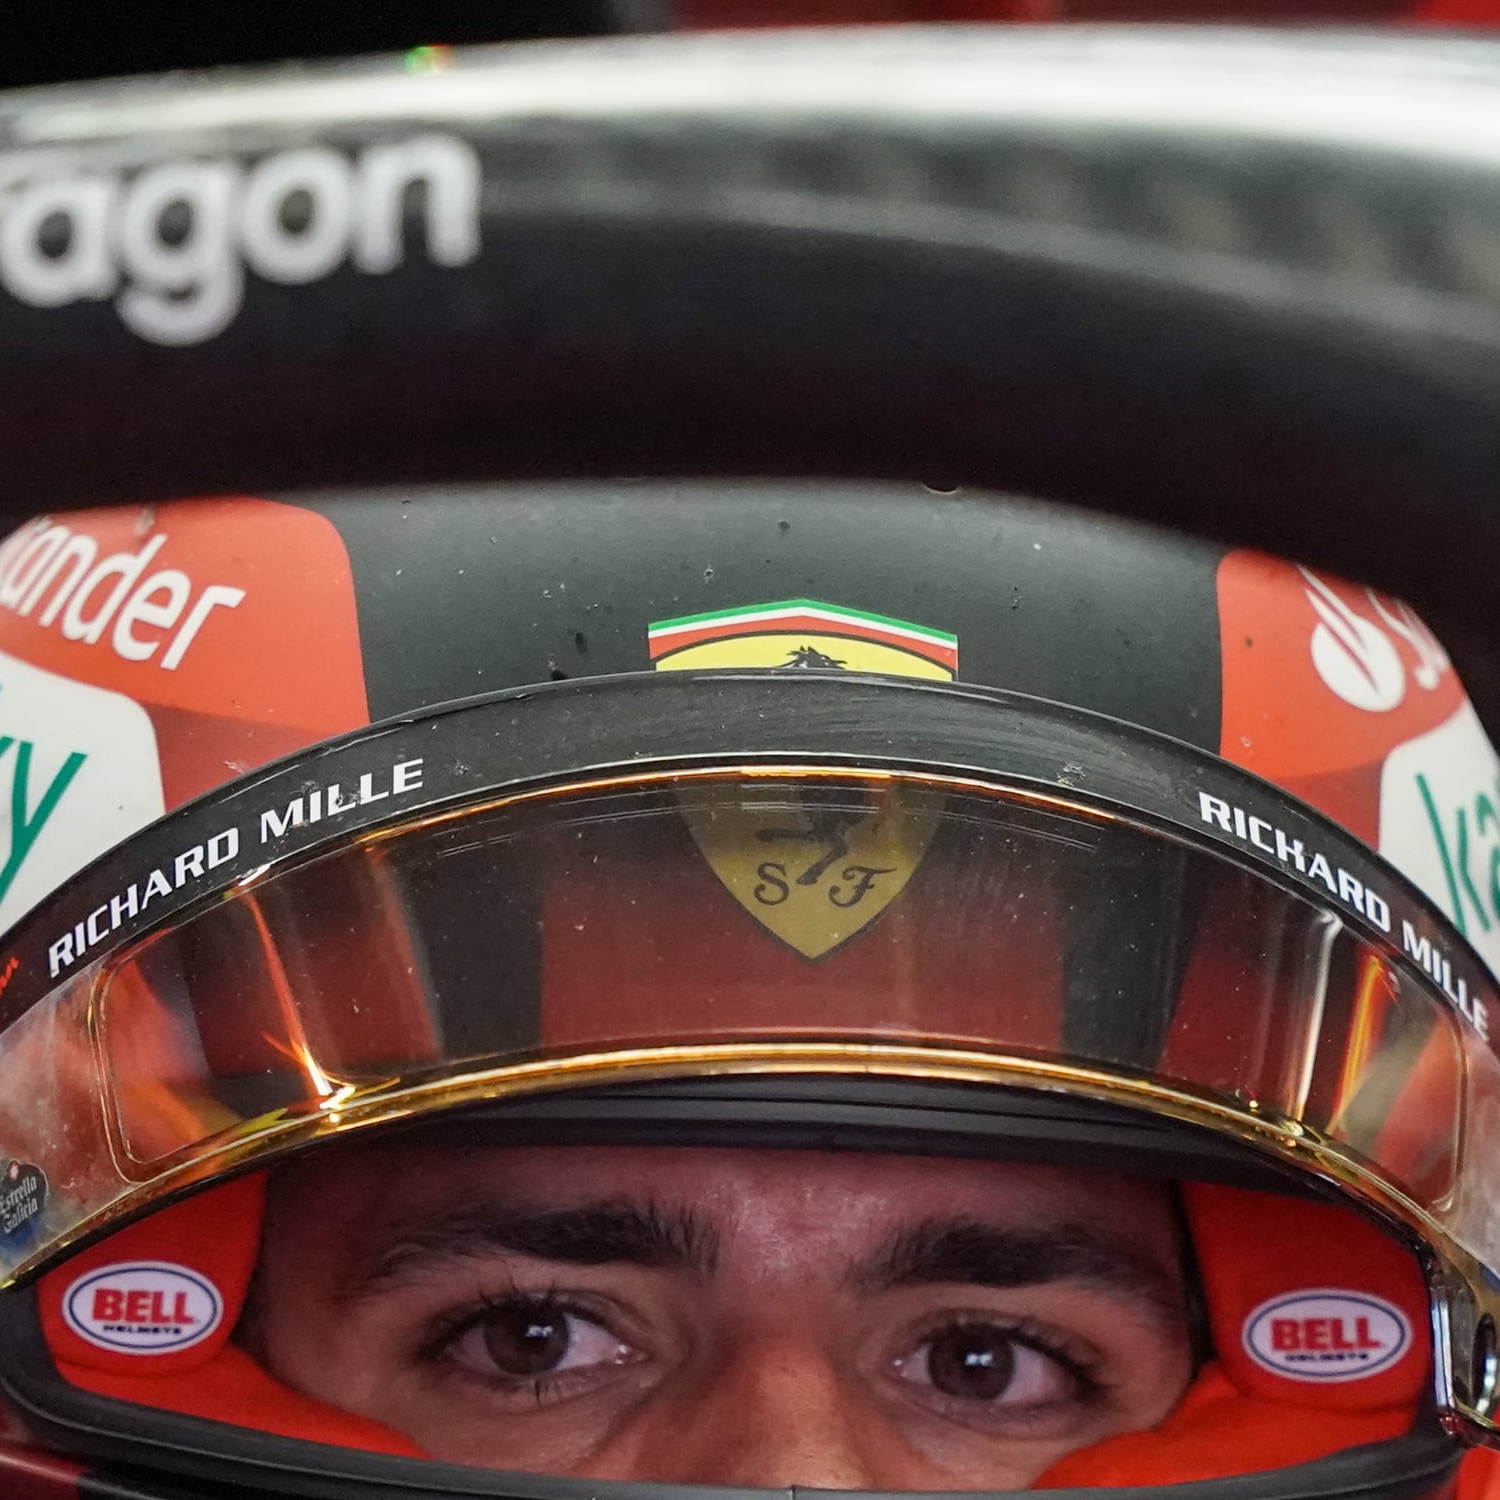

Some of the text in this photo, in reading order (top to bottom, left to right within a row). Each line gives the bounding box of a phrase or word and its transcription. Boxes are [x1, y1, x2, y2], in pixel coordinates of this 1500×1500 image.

[49, 758, 424, 978] RICHARD MILLE
[1198, 791, 1489, 1042] RICHARD MILLE
[0, 1176, 37, 1215] Estrella
[92, 1289, 194, 1324] BELL
[1271, 1317, 1381, 1351] BELL
